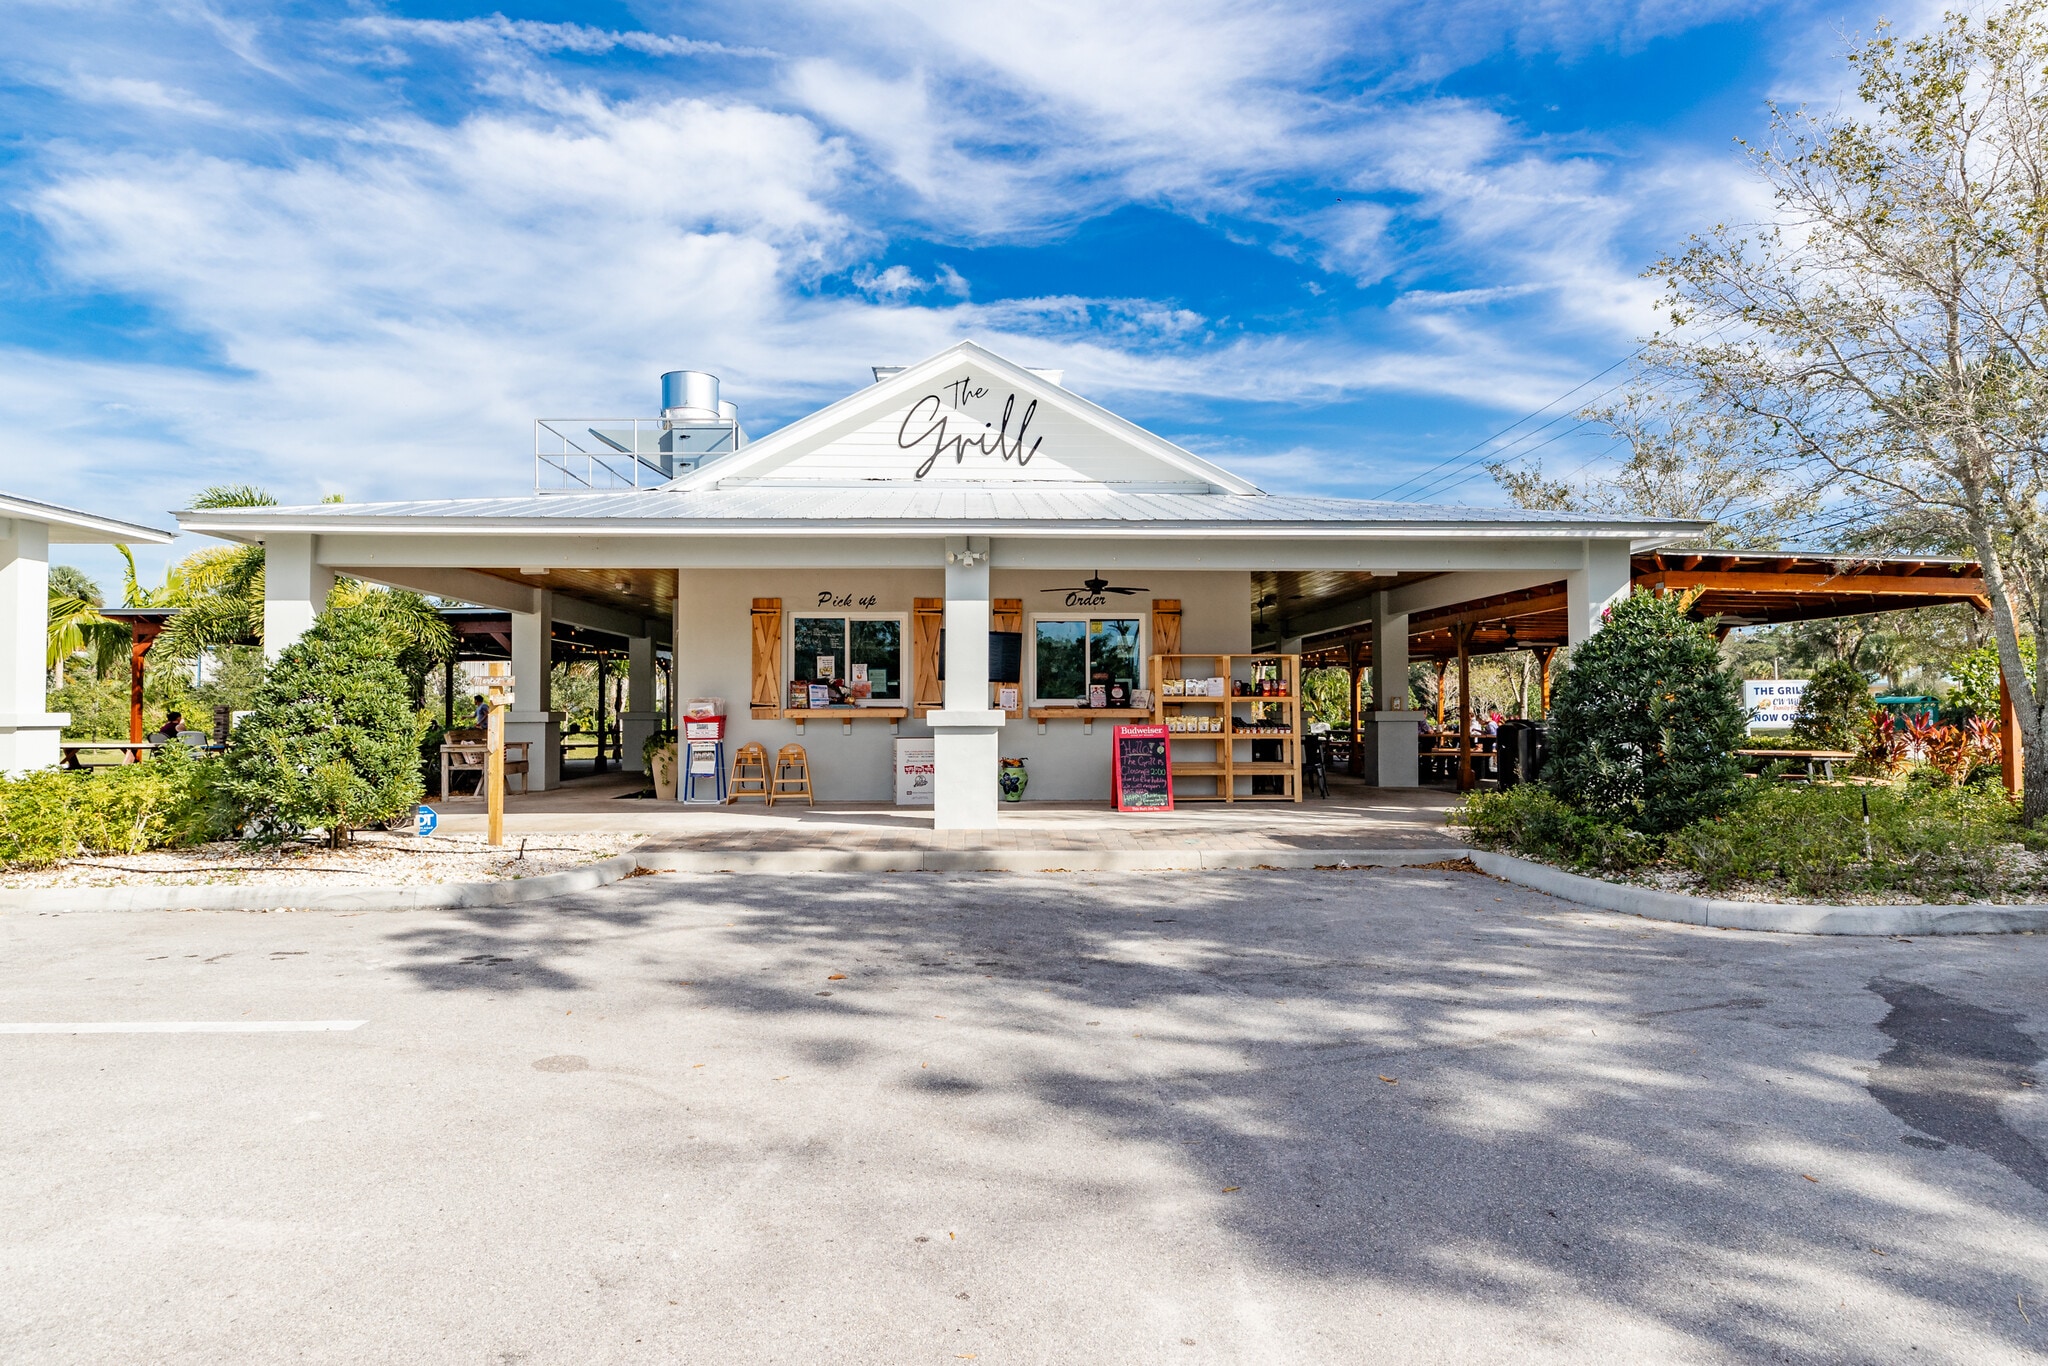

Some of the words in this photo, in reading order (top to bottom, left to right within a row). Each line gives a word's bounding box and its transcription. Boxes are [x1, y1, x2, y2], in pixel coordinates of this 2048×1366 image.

[943, 376, 989, 410] The
[898, 393, 1043, 479] Grill
[817, 591, 852, 607] Pick
[858, 594, 878, 609] up
[1065, 591, 1107, 607] Order
[1753, 687, 1774, 695] THE
[1754, 713, 1778, 722] NOW
[1120, 726, 1163, 735] Budweiser
[1150, 768, 1166, 776] 2:00
